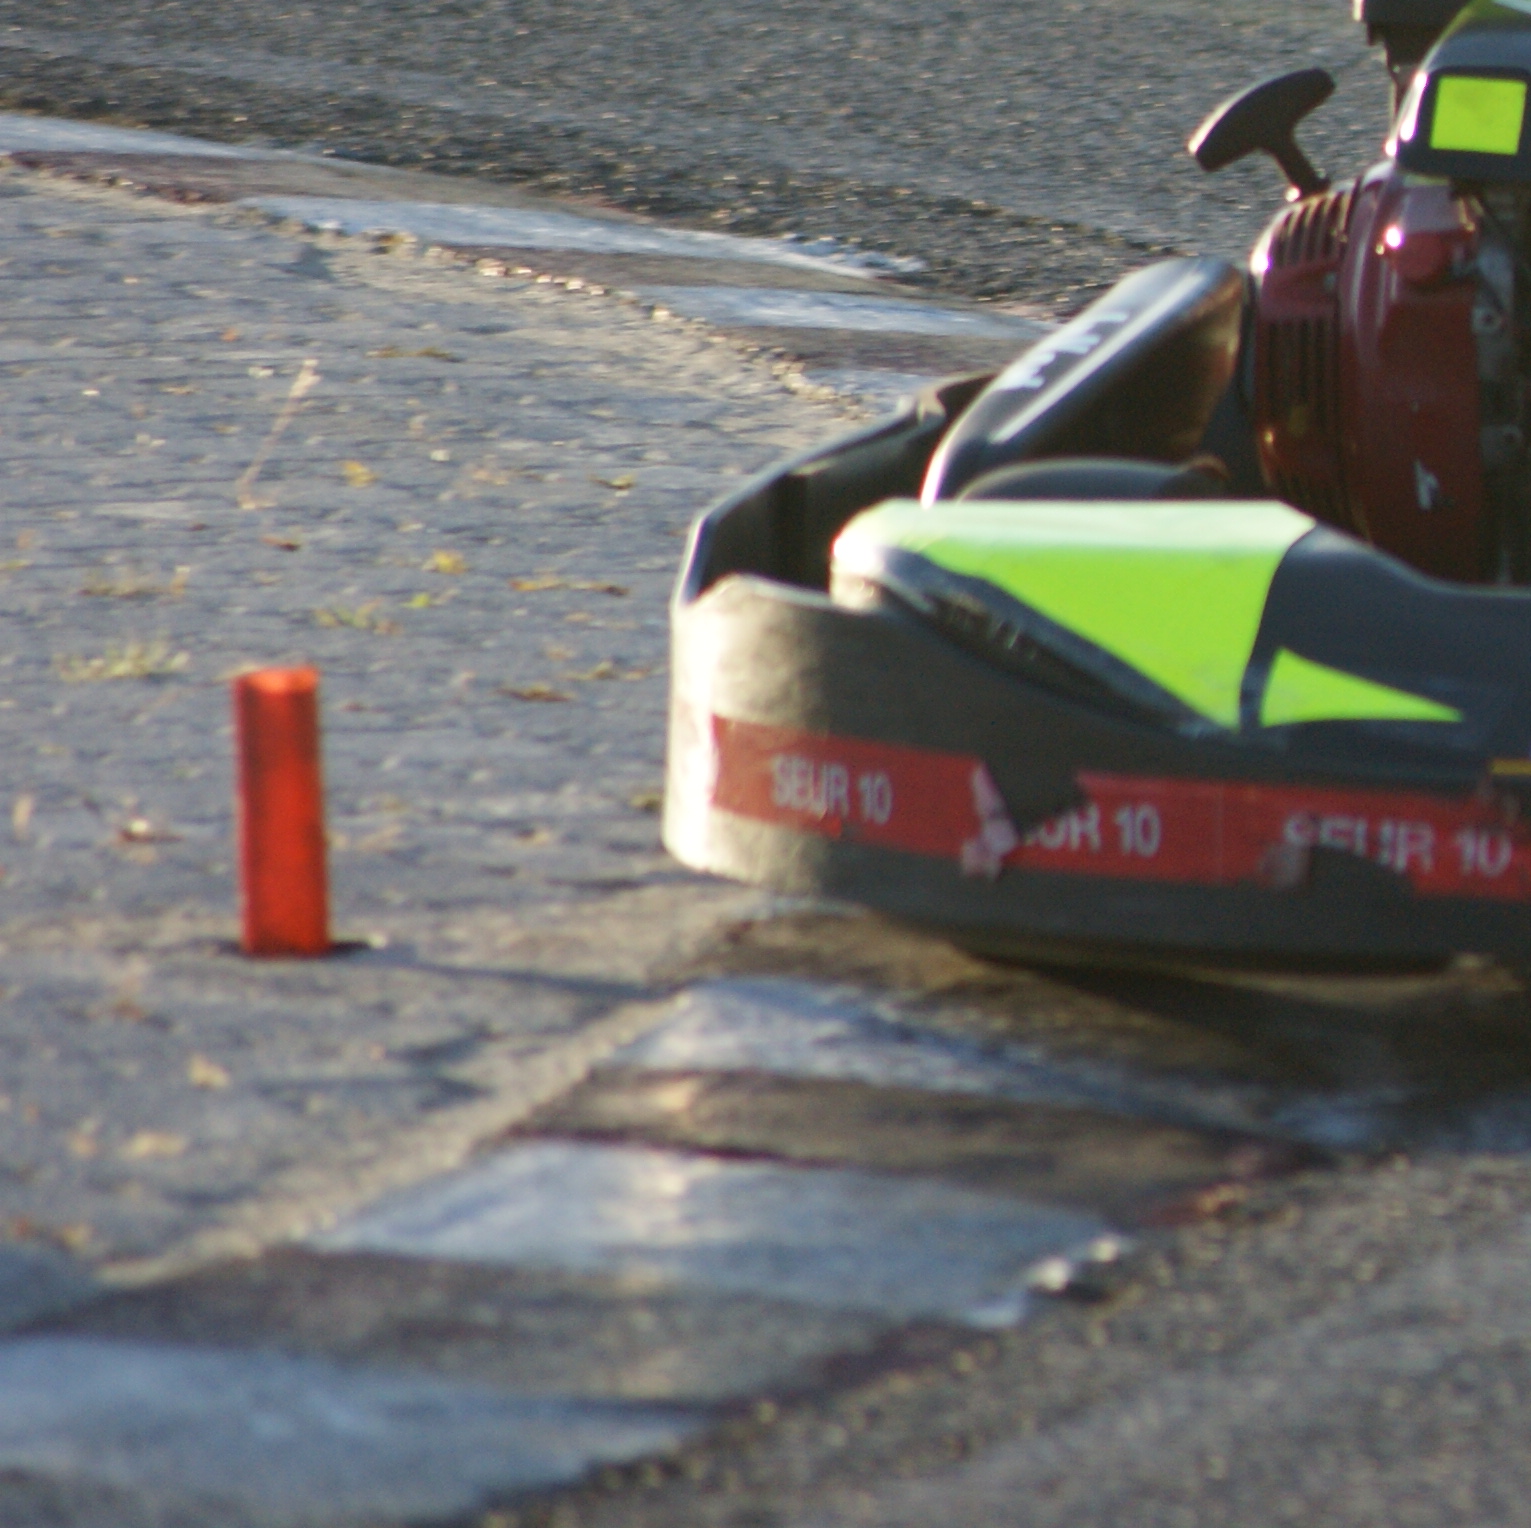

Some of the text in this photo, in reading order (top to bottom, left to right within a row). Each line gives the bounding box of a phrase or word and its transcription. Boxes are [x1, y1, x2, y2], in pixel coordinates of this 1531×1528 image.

[771, 752, 894, 825] SEUR 10
[1114, 802, 1162, 858] 10
